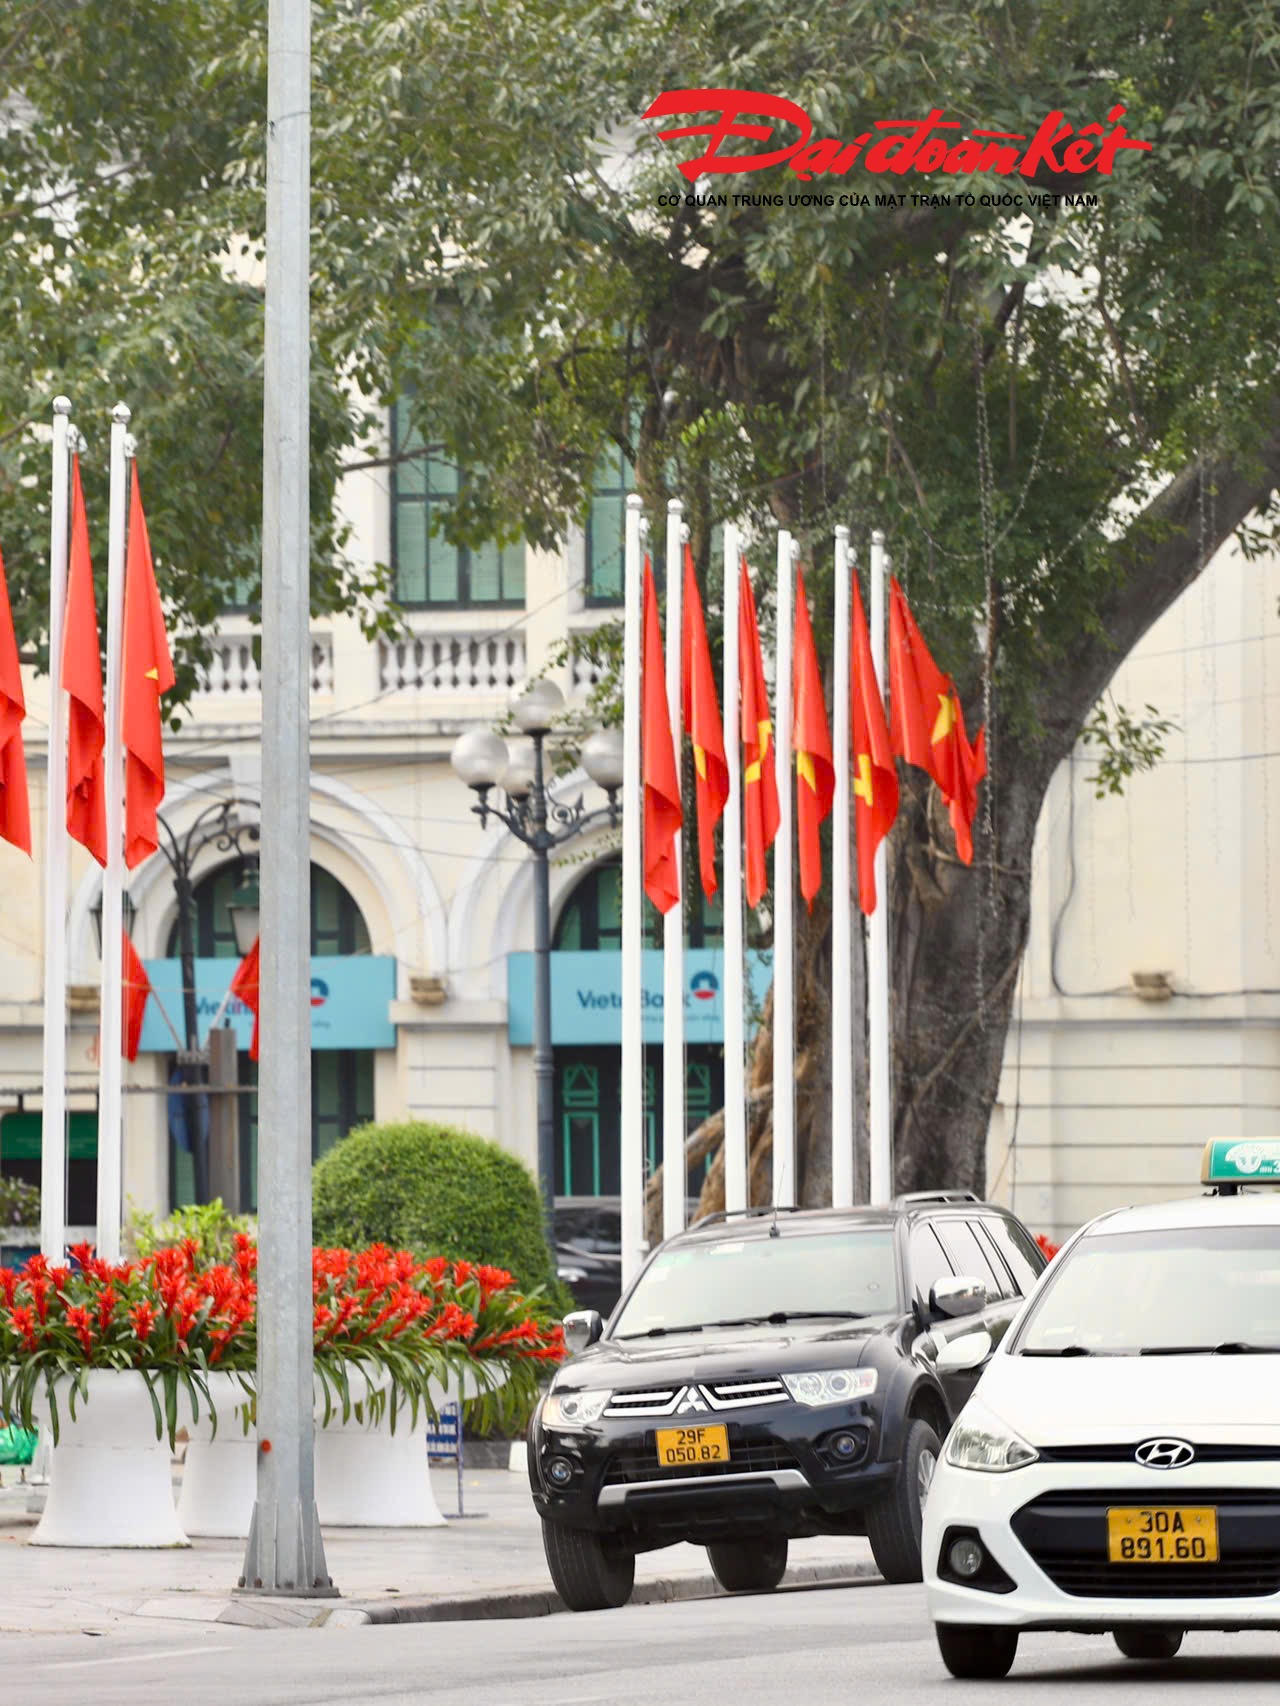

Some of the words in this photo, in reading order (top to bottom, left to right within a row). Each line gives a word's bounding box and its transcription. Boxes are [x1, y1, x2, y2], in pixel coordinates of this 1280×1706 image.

[676, 1428, 706, 1445] 29F
[665, 1445, 721, 1463] 050.82
[1140, 1511, 1184, 1533] 30A
[1120, 1537, 1206, 1559] 891.60
